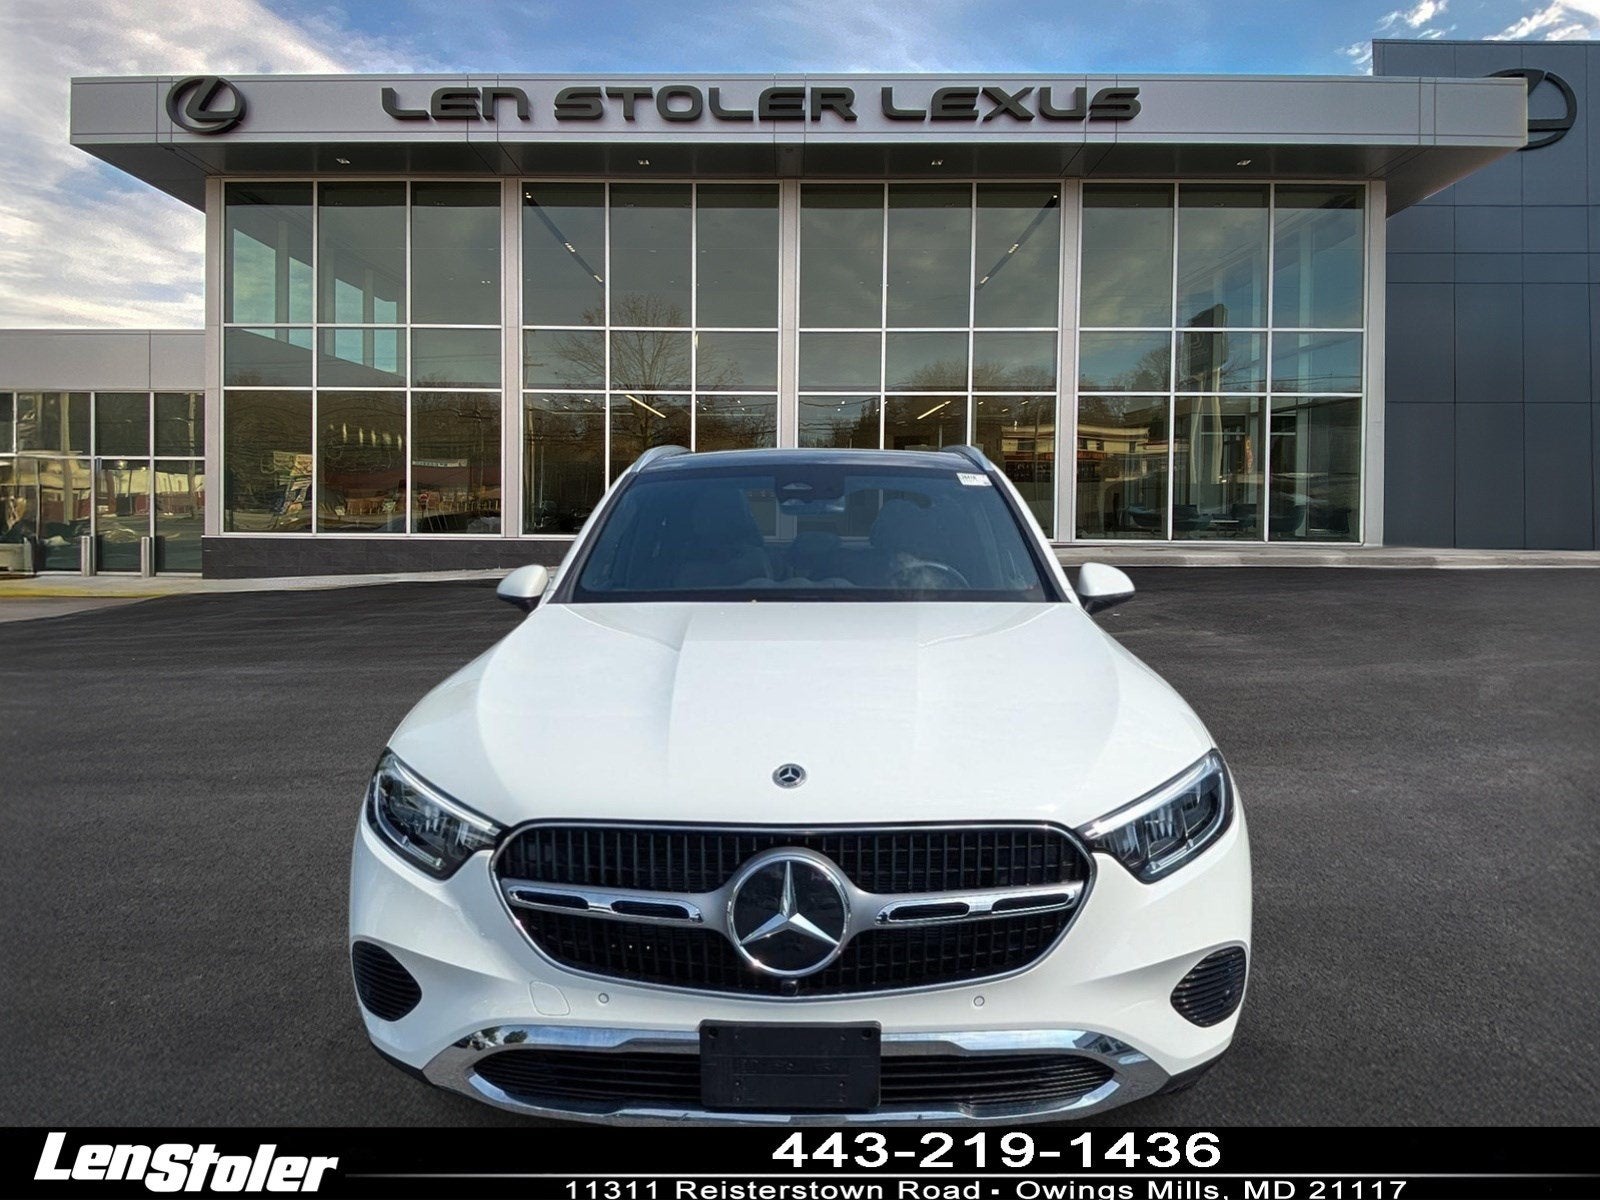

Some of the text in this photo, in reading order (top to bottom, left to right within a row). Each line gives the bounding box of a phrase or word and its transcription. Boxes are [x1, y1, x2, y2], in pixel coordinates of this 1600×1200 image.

[382, 86, 1141, 122] LEN STOLER LEXUS
